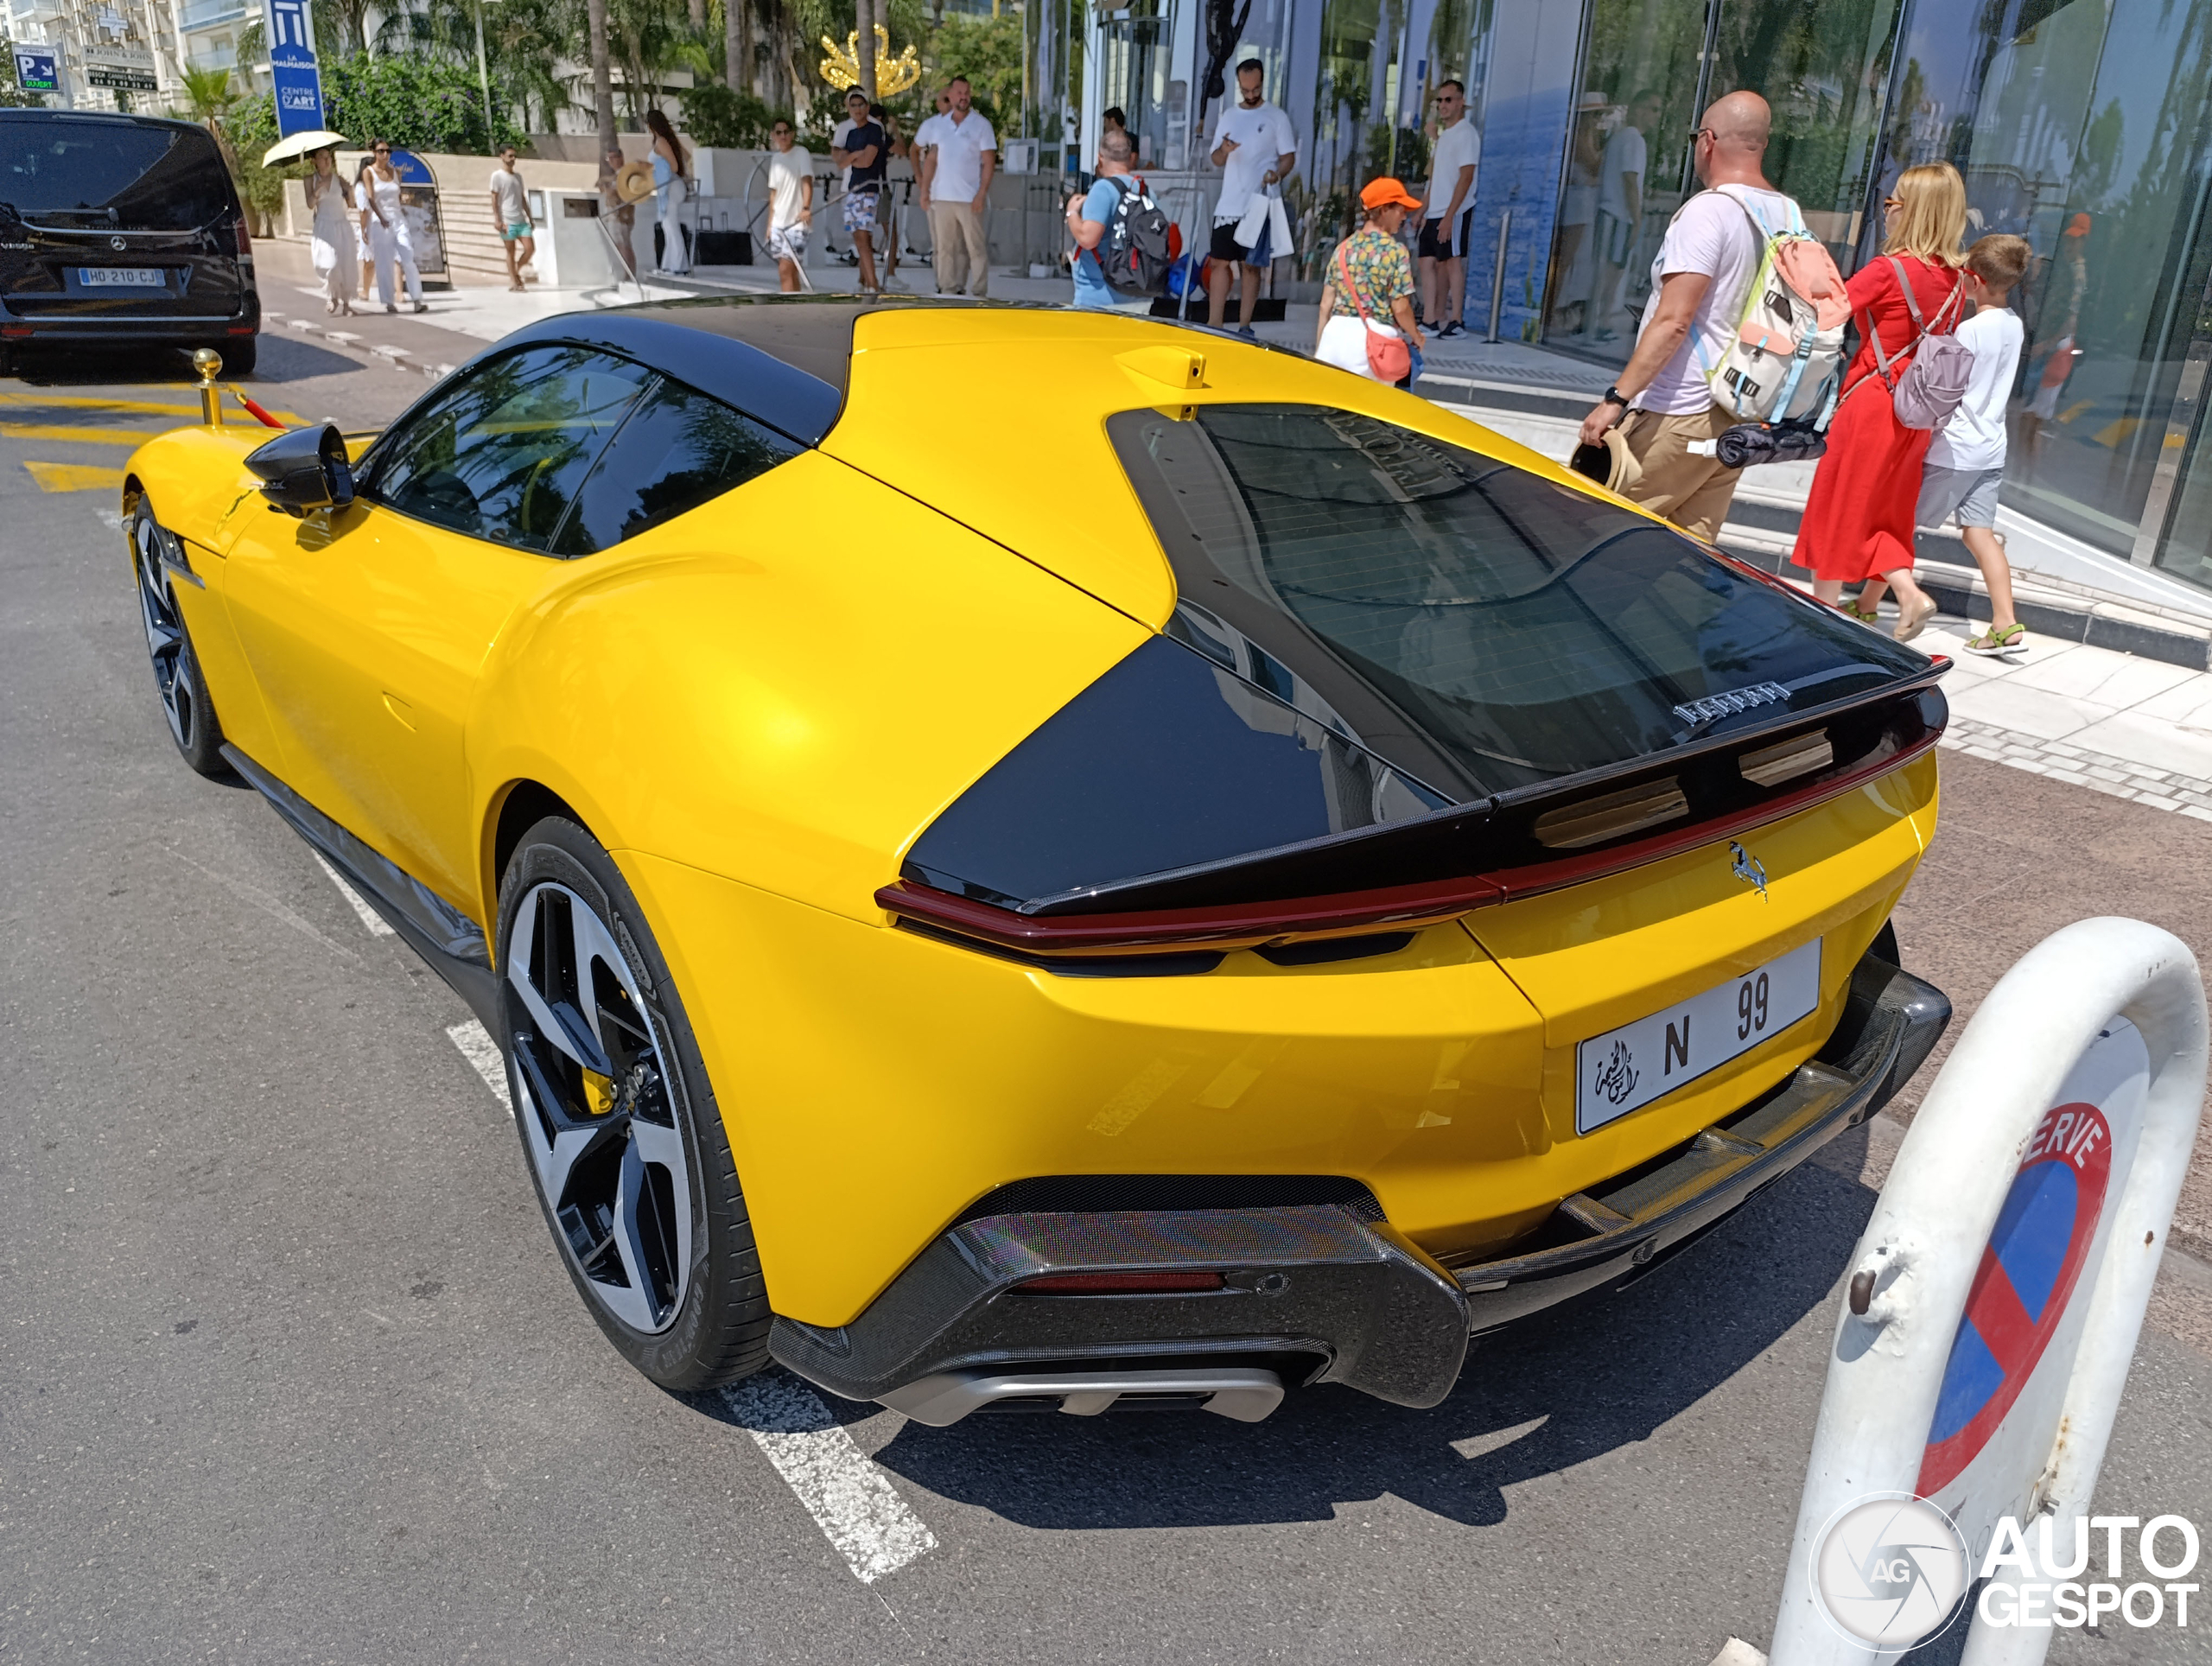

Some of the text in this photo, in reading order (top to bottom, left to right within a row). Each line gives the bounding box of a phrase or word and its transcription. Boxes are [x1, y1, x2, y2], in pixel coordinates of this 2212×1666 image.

[97, 48, 119, 57] JOHN
[130, 53, 152, 61] JOHN
[19, 56, 35, 74] P
[273, 59, 316, 70] MALMAISON
[26, 80, 53, 89] OUVERT
[281, 86, 315, 97] CENTRE
[283, 93, 316, 107] D'ART
[1664, 972, 1769, 1077] N 99
[2023, 1112, 2103, 1169] ERVE
